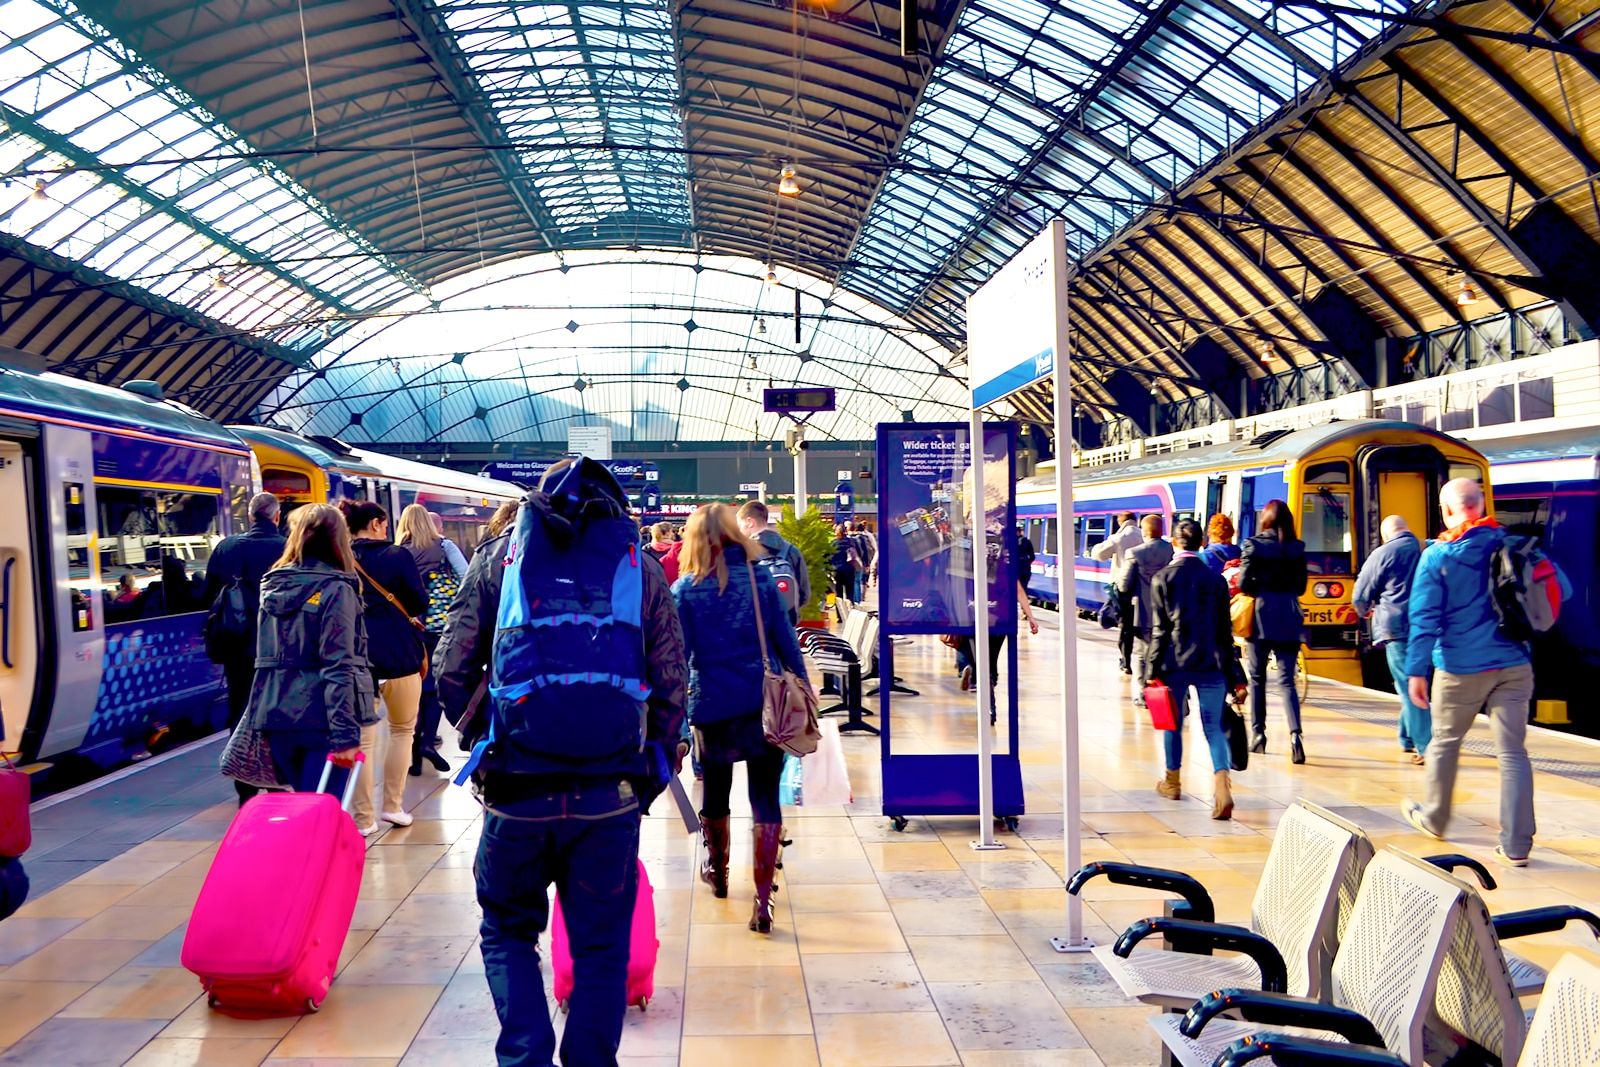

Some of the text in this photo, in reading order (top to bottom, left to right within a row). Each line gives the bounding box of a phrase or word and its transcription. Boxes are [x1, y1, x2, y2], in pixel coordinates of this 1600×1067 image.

[902, 440, 970, 452] Wider ticket ga
[531, 462, 550, 470] Glasg
[671, 504, 698, 514] KING
[1302, 608, 1333, 623] First
